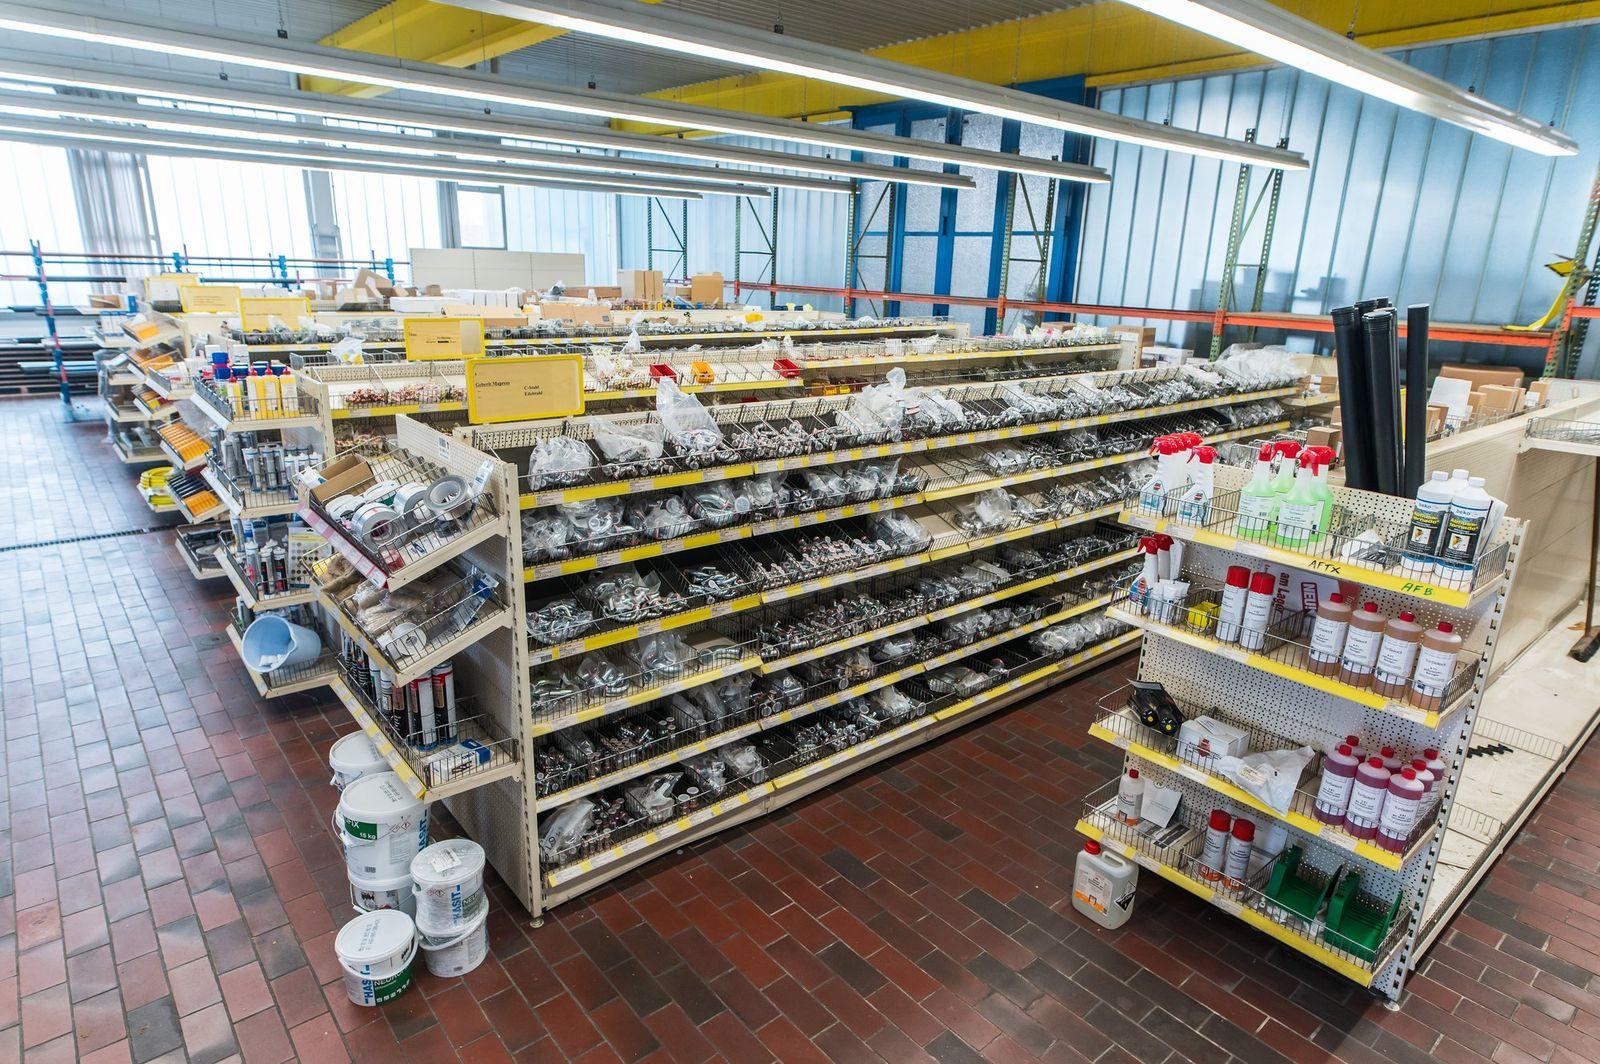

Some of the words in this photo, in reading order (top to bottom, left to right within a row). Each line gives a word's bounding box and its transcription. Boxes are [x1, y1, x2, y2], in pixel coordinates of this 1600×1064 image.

[1308, 559, 1342, 575] AFTX
[1400, 583, 1434, 597] AFB
[367, 833, 377, 841] kg
[450, 890, 462, 921] HASIT
